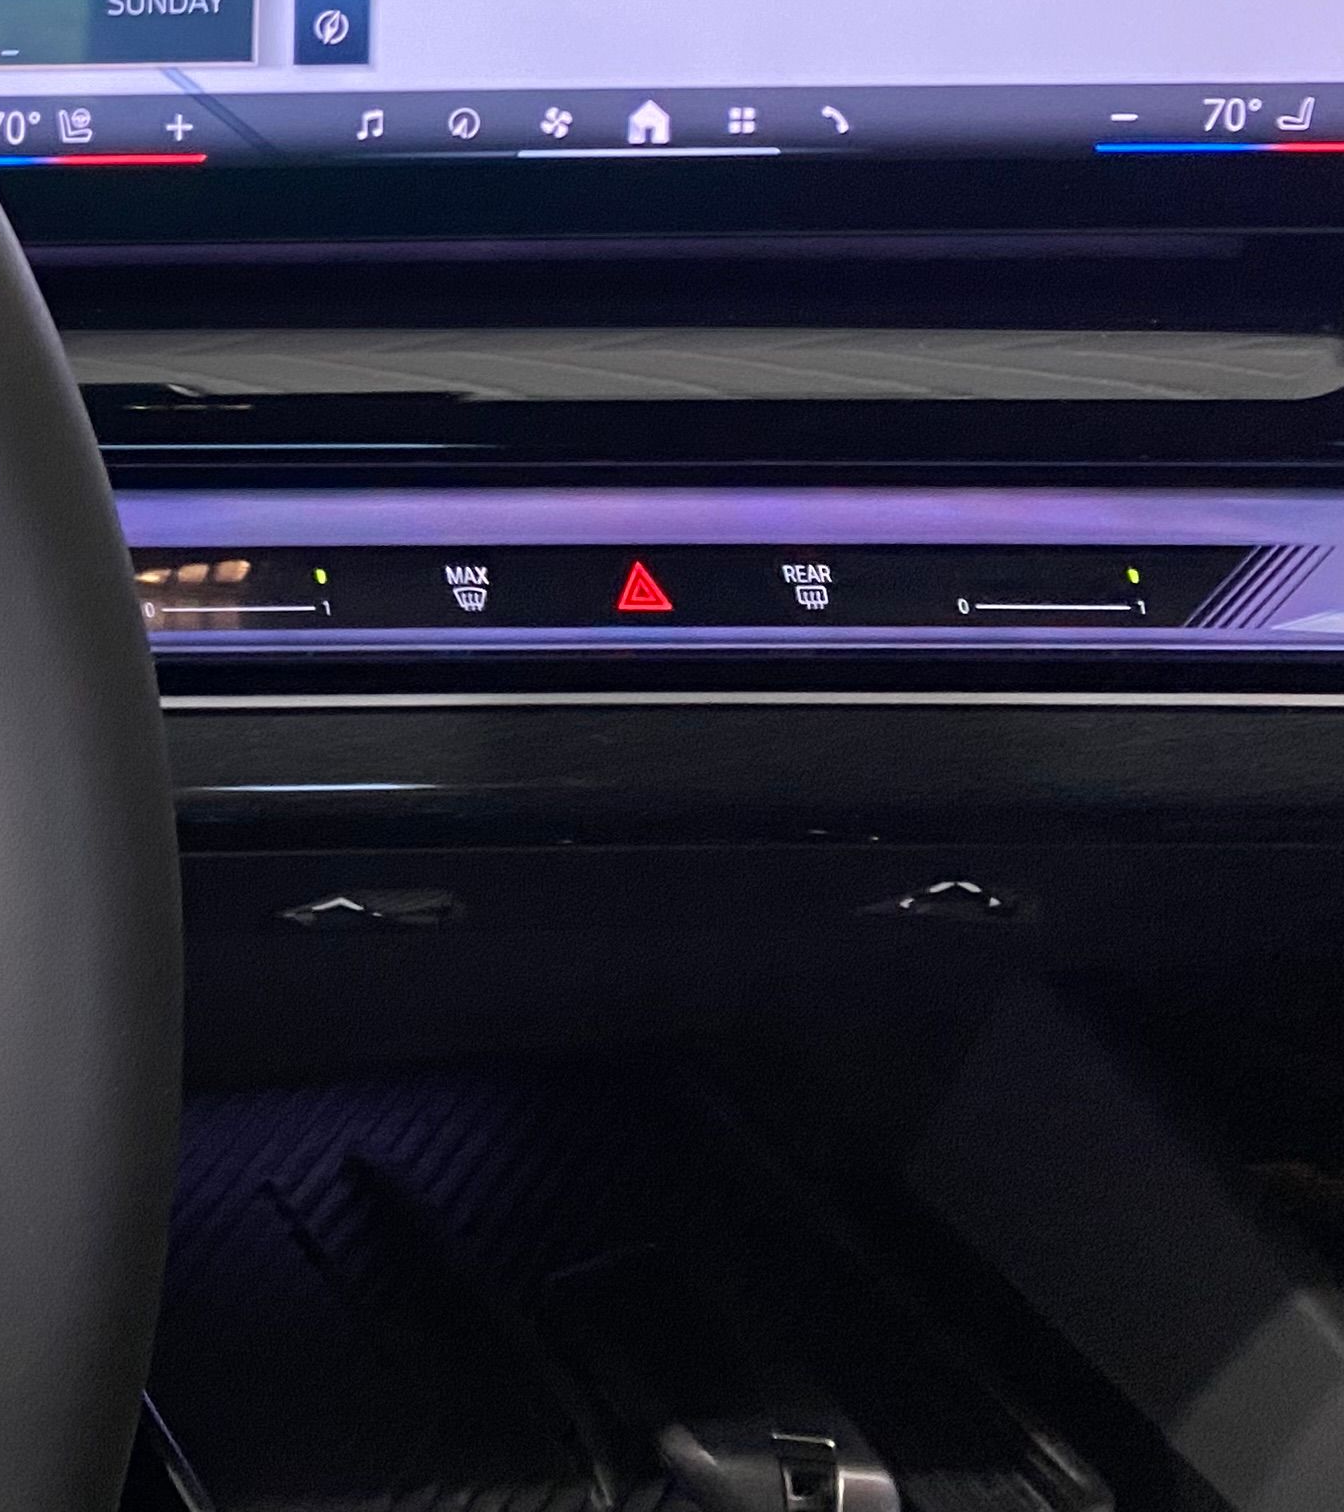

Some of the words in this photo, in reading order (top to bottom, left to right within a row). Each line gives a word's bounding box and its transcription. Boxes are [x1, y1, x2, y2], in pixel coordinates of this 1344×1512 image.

[1203, 97, 1262, 132] 70°
[446, 566, 489, 585] MAX
[782, 565, 832, 584] REAR
[141, 602, 155, 618] 0
[322, 600, 331, 617] 1
[958, 598, 970, 615] 0
[1137, 600, 1147, 616] 1
